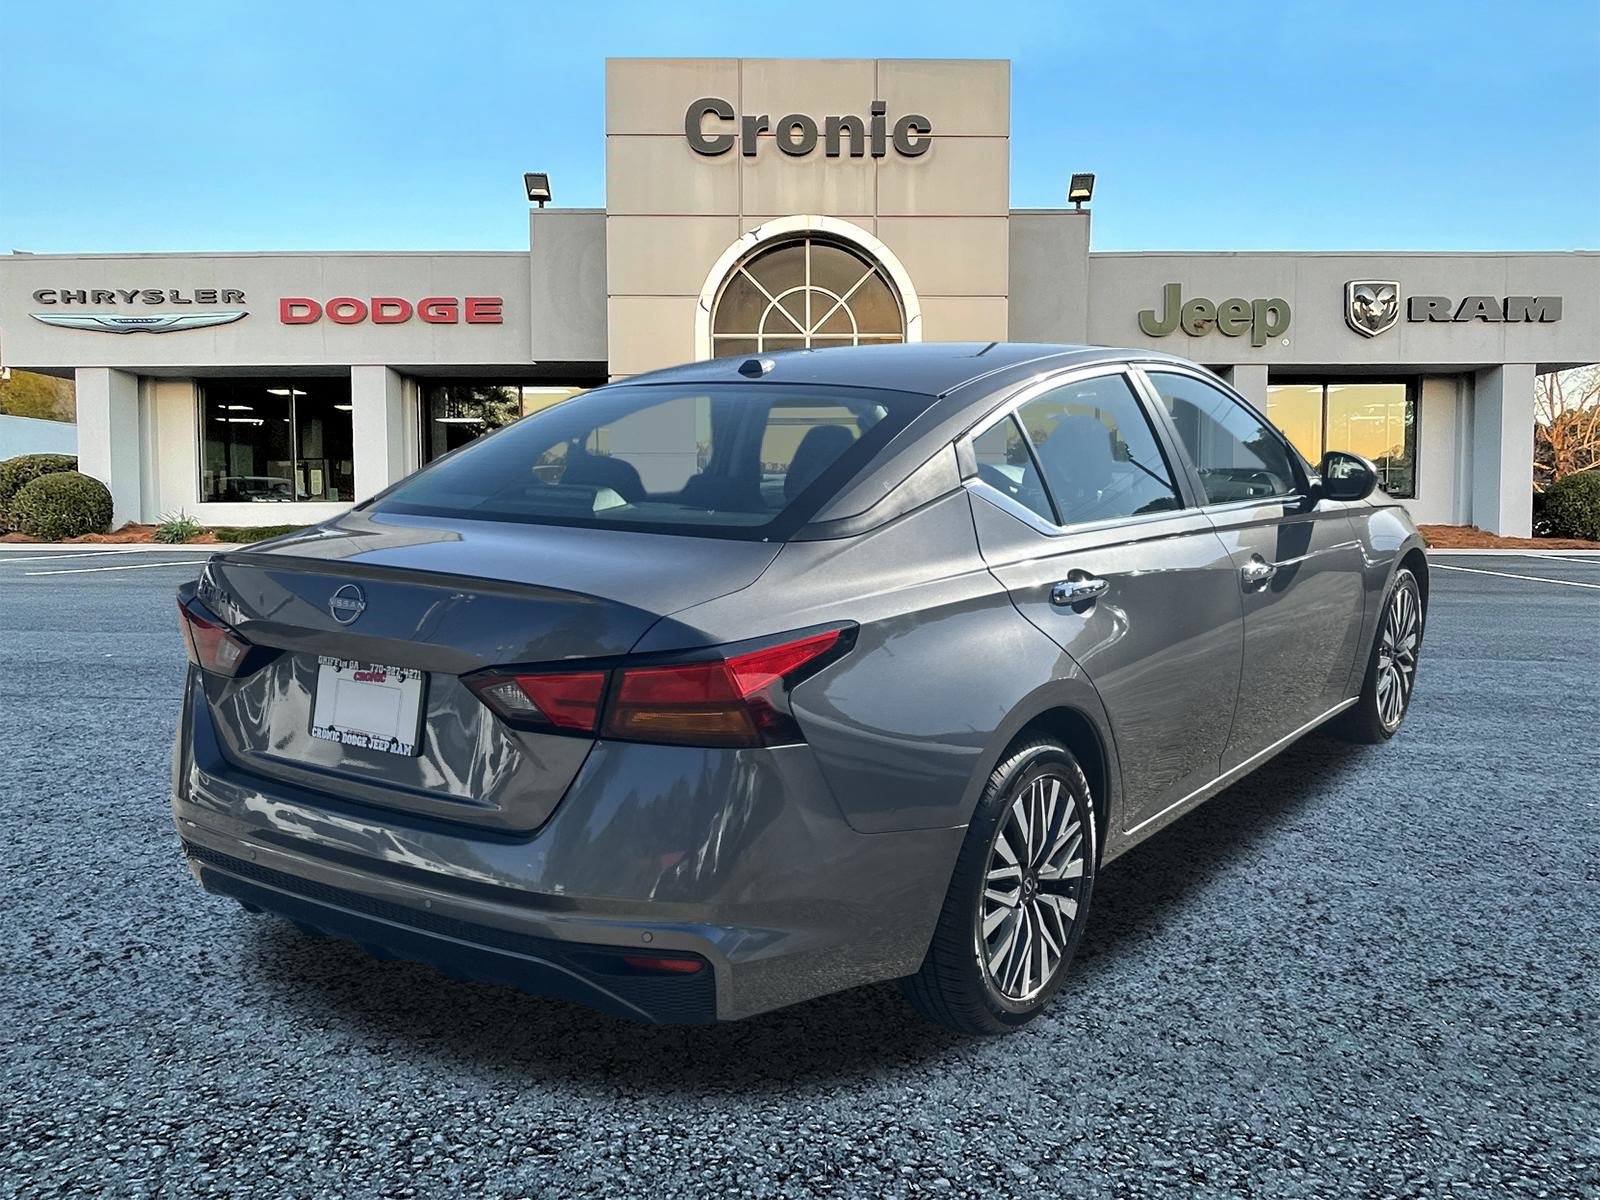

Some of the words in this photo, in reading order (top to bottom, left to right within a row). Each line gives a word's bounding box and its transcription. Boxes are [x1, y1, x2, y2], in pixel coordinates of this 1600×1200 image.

[685, 97, 932, 158] Cronic
[32, 289, 246, 305] CHRYSLER
[279, 297, 503, 324] DODGE
[1407, 296, 1563, 323] RAM
[1138, 283, 1291, 347] Jeep
[342, 732, 368, 748] DODGE
[368, 738, 390, 752] JEEP
[390, 743, 412, 757] RAM
